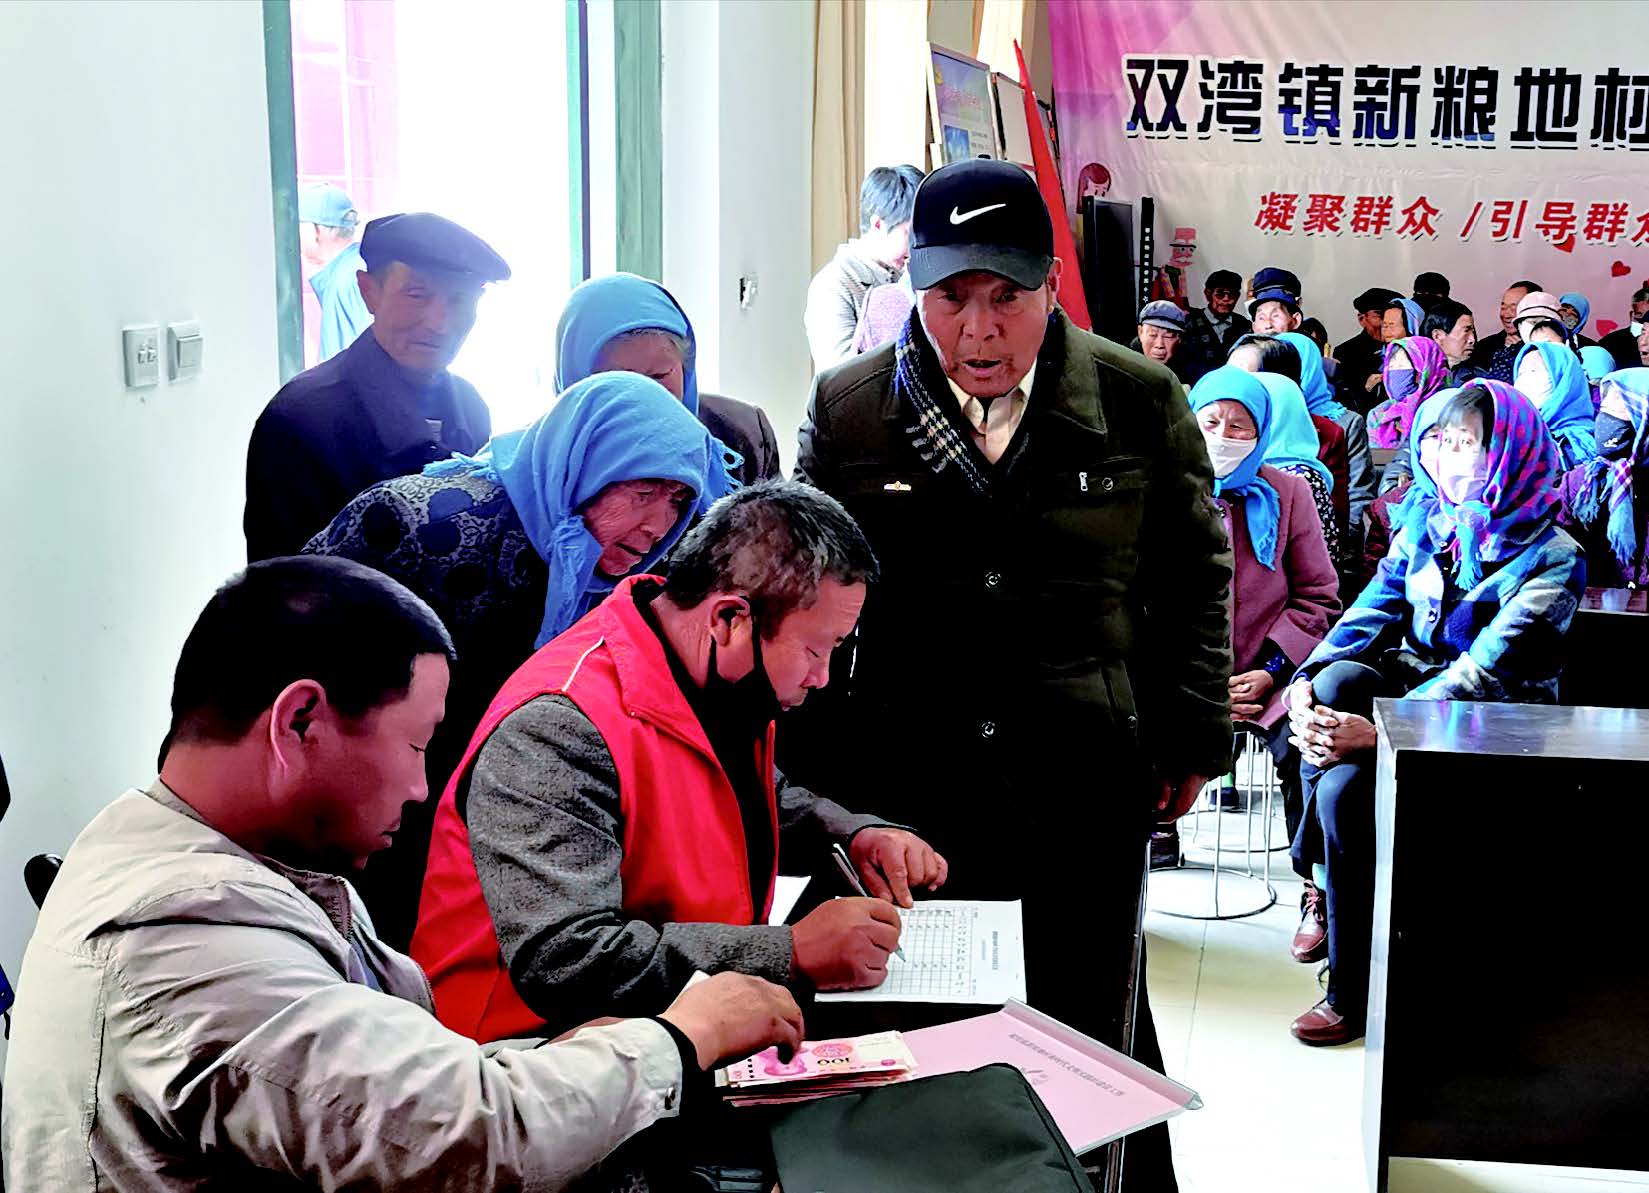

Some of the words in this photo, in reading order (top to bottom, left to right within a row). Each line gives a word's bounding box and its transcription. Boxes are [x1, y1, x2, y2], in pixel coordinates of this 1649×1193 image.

[1126, 59, 1649, 145] 双湾镇新粮地村
[1254, 192, 1440, 238] 凝聚群众
[817, 1057, 850, 1066] 100
